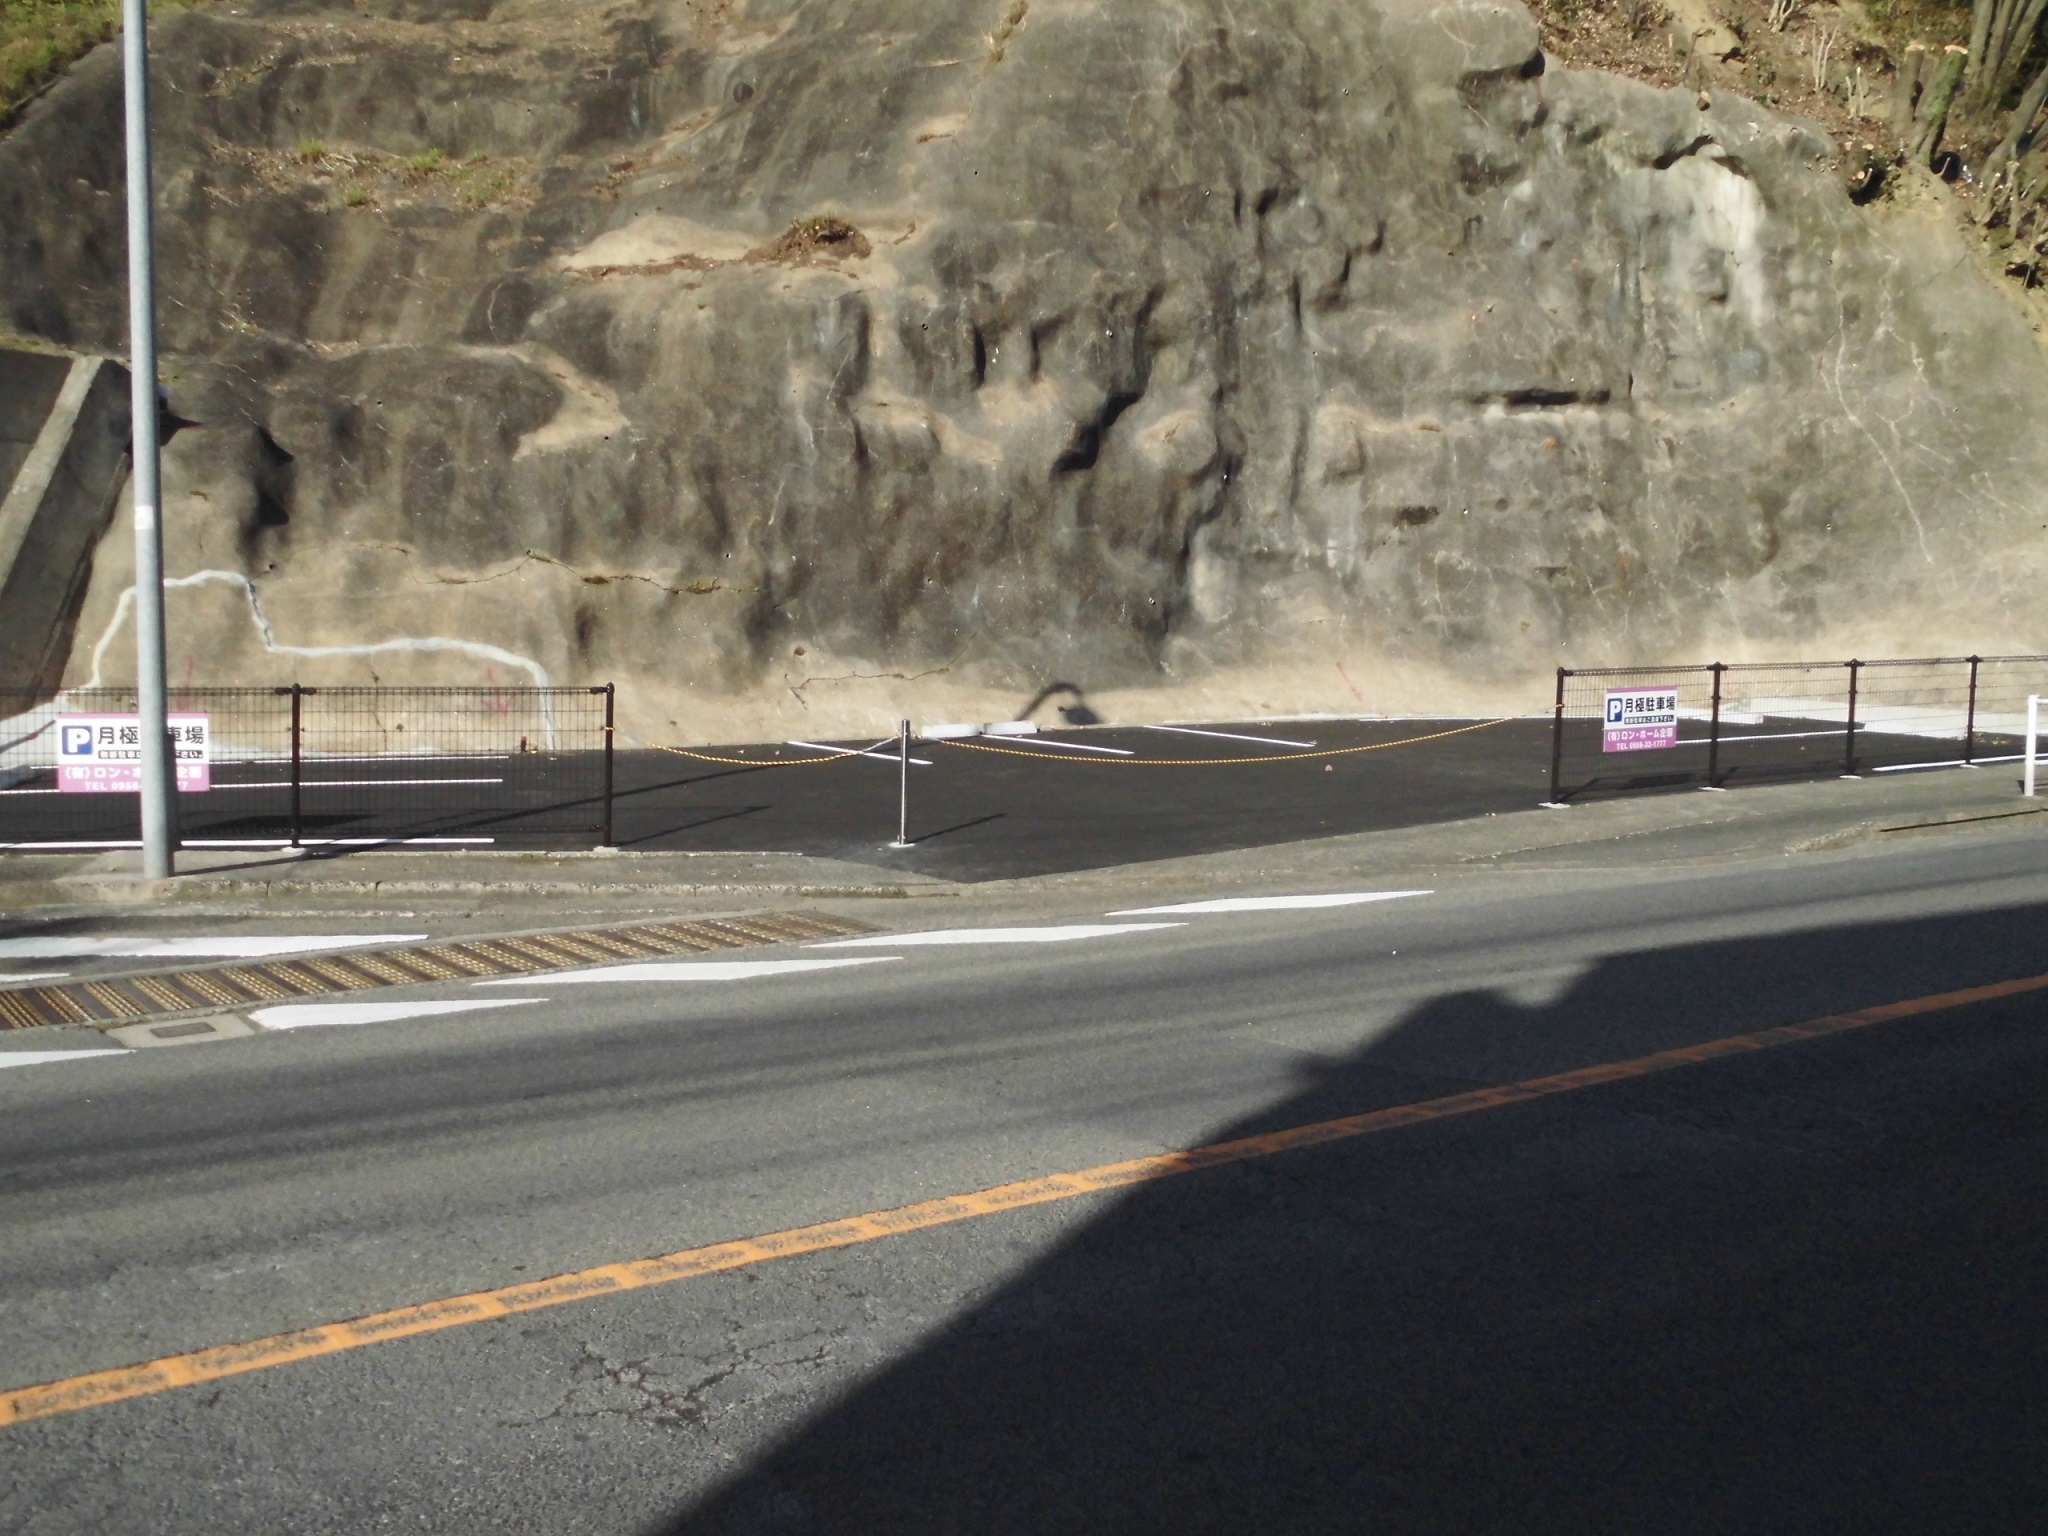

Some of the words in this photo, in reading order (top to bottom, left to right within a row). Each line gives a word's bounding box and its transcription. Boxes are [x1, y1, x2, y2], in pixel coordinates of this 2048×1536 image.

[1624, 696, 1675, 713] 月極駐車場
[98, 726, 204, 745] 月極車場
[84, 782, 107, 791] TEL
